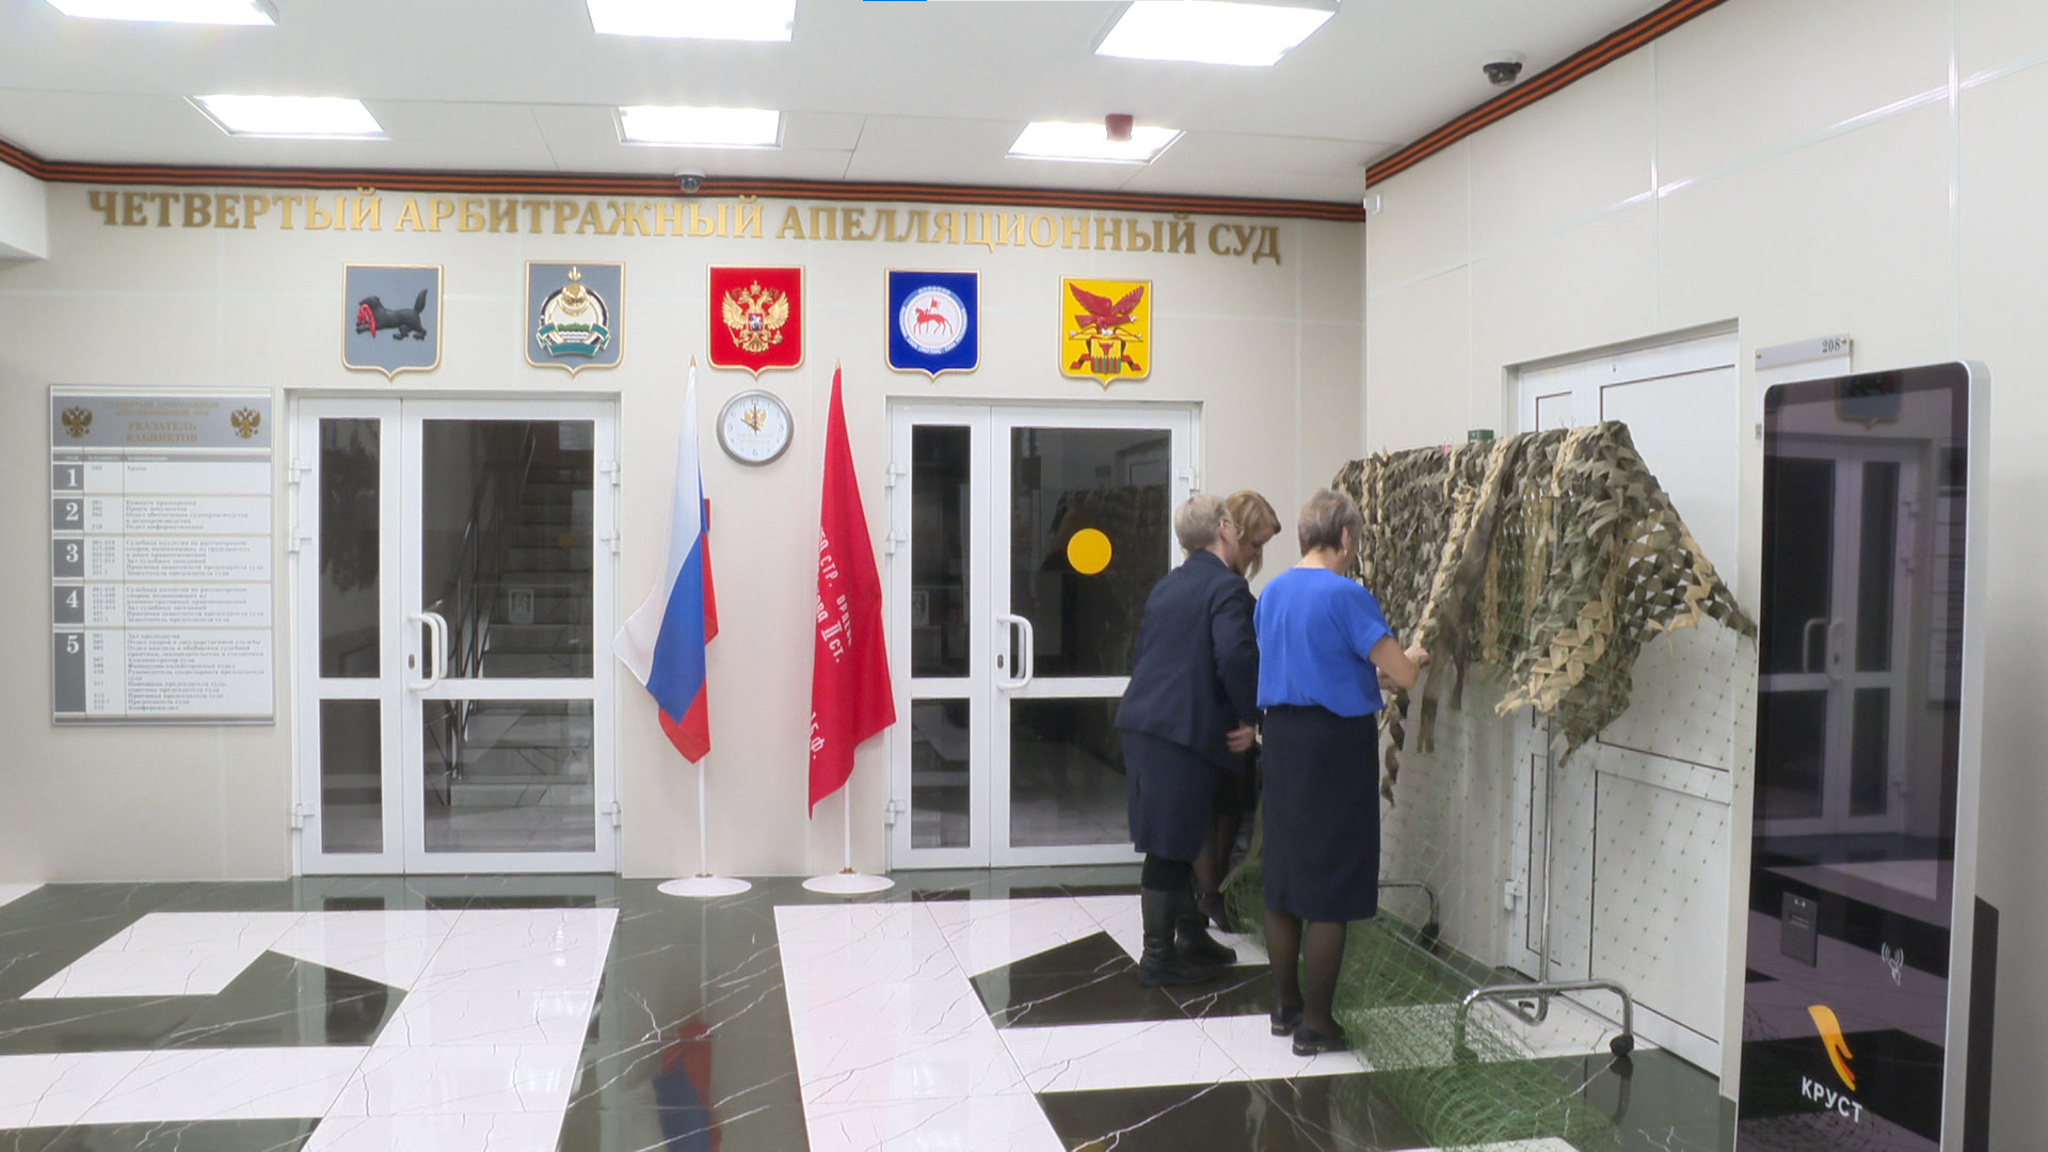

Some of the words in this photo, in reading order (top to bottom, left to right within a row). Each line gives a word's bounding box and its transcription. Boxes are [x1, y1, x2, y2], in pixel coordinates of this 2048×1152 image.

[88, 186, 382, 231] ЧЕТВЕРТЫЙ
[395, 194, 764, 239] АРБИТРАЖНЫЙ
[776, 205, 1196, 254] АПЕЛЛЯЦИОННЫЙ
[1208, 222, 1281, 265] СУД
[1822, 337, 1841, 353] 208
[67, 468, 79, 487] 1
[66, 502, 79, 521] 2
[66, 543, 79, 563] 3
[66, 590, 79, 608] 4
[67, 634, 79, 653] 5
[1801, 1076, 1863, 1123] КРУСТ
